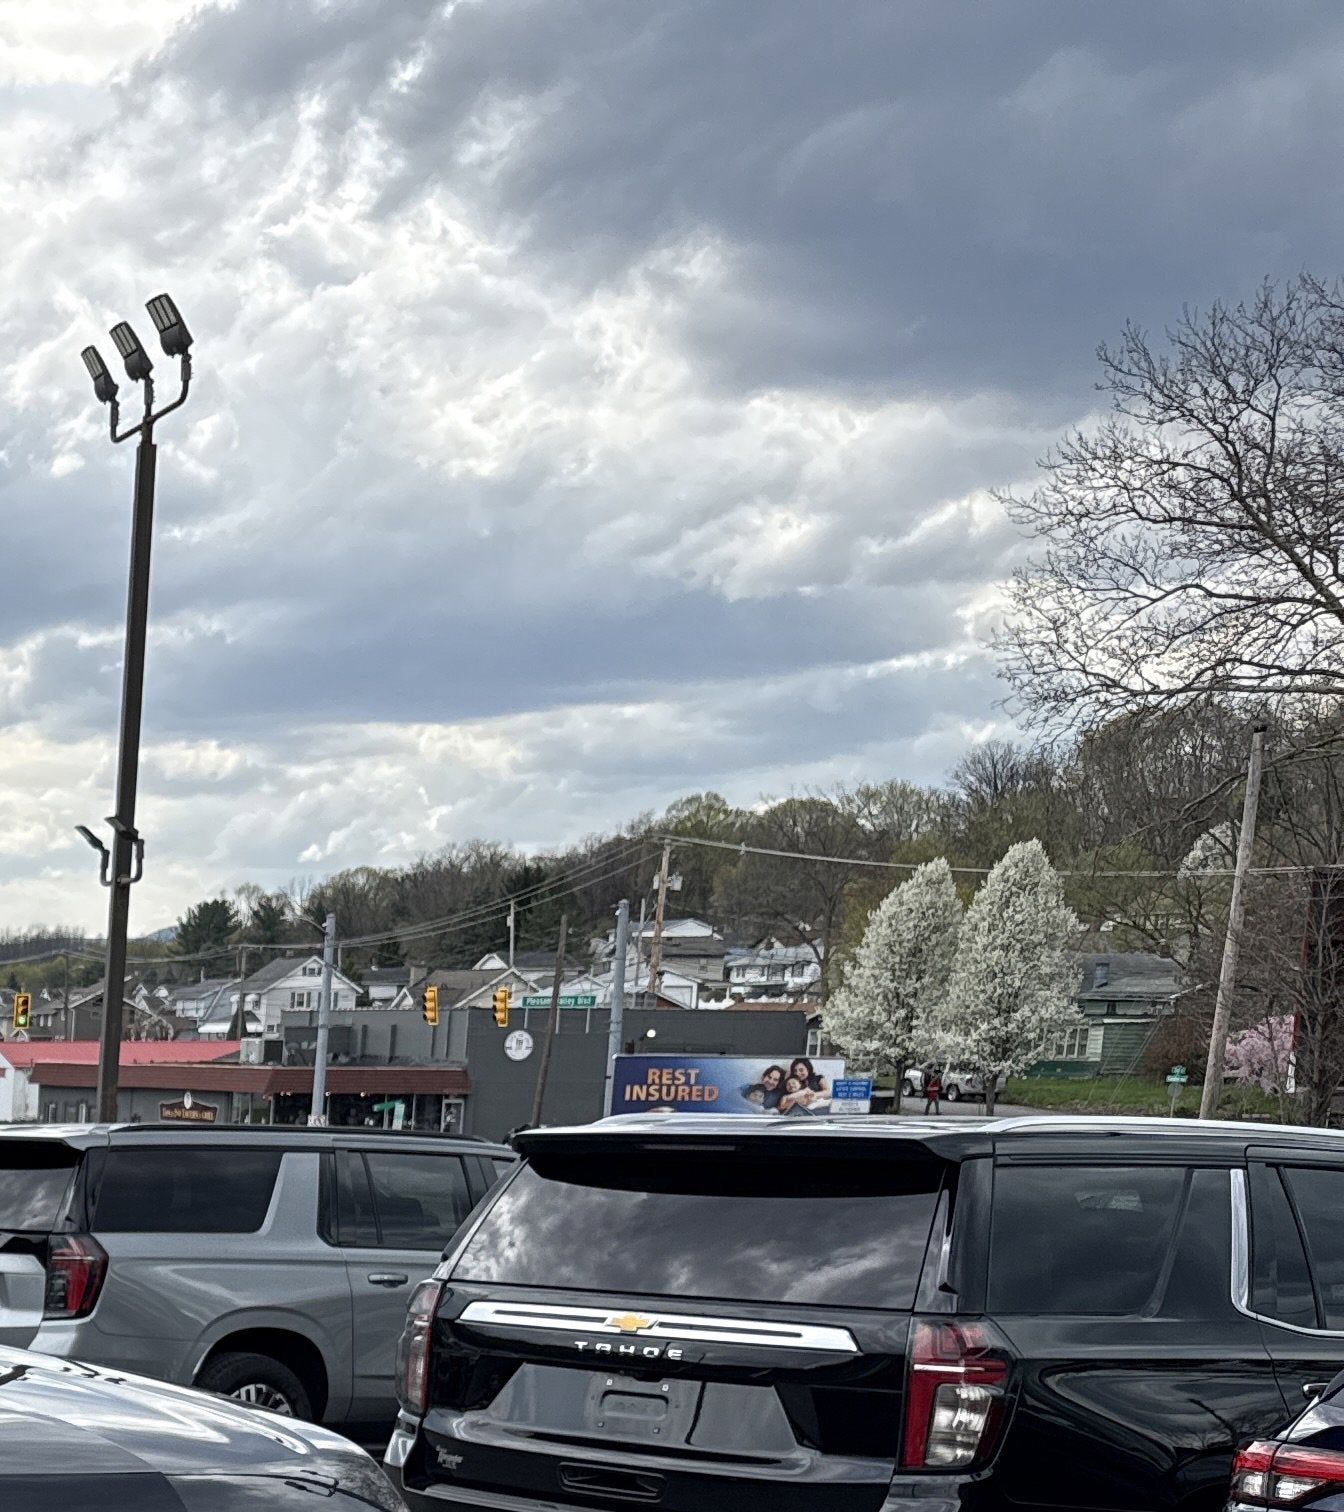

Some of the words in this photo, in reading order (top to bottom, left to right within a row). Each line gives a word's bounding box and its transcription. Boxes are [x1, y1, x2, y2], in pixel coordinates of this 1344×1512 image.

[647, 1067, 700, 1085] REST
[624, 1084, 720, 1102] INSURED
[574, 1340, 683, 1360] TAHOE
